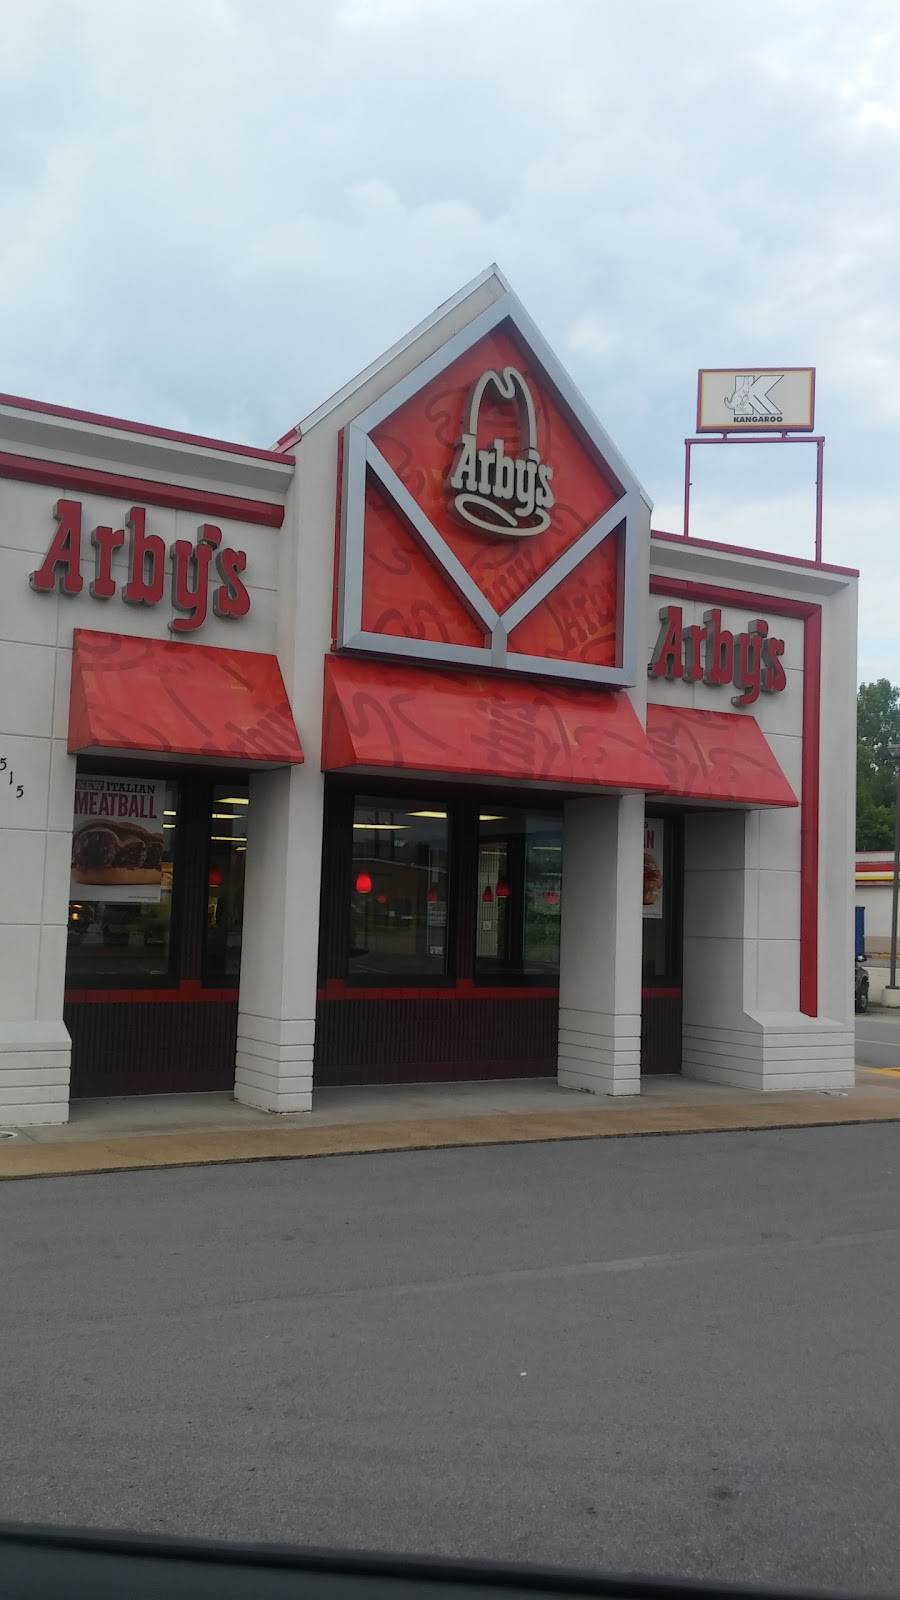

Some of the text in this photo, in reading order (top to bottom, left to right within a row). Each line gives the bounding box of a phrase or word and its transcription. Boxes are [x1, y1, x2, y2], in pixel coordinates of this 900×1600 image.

[450, 433, 555, 517] Arby's
[30, 499, 250, 631] Arby's
[649, 606, 786, 706] Arby's
[74, 790, 157, 818] MEATBALL
[106, 781, 155, 794] ITALIAN
